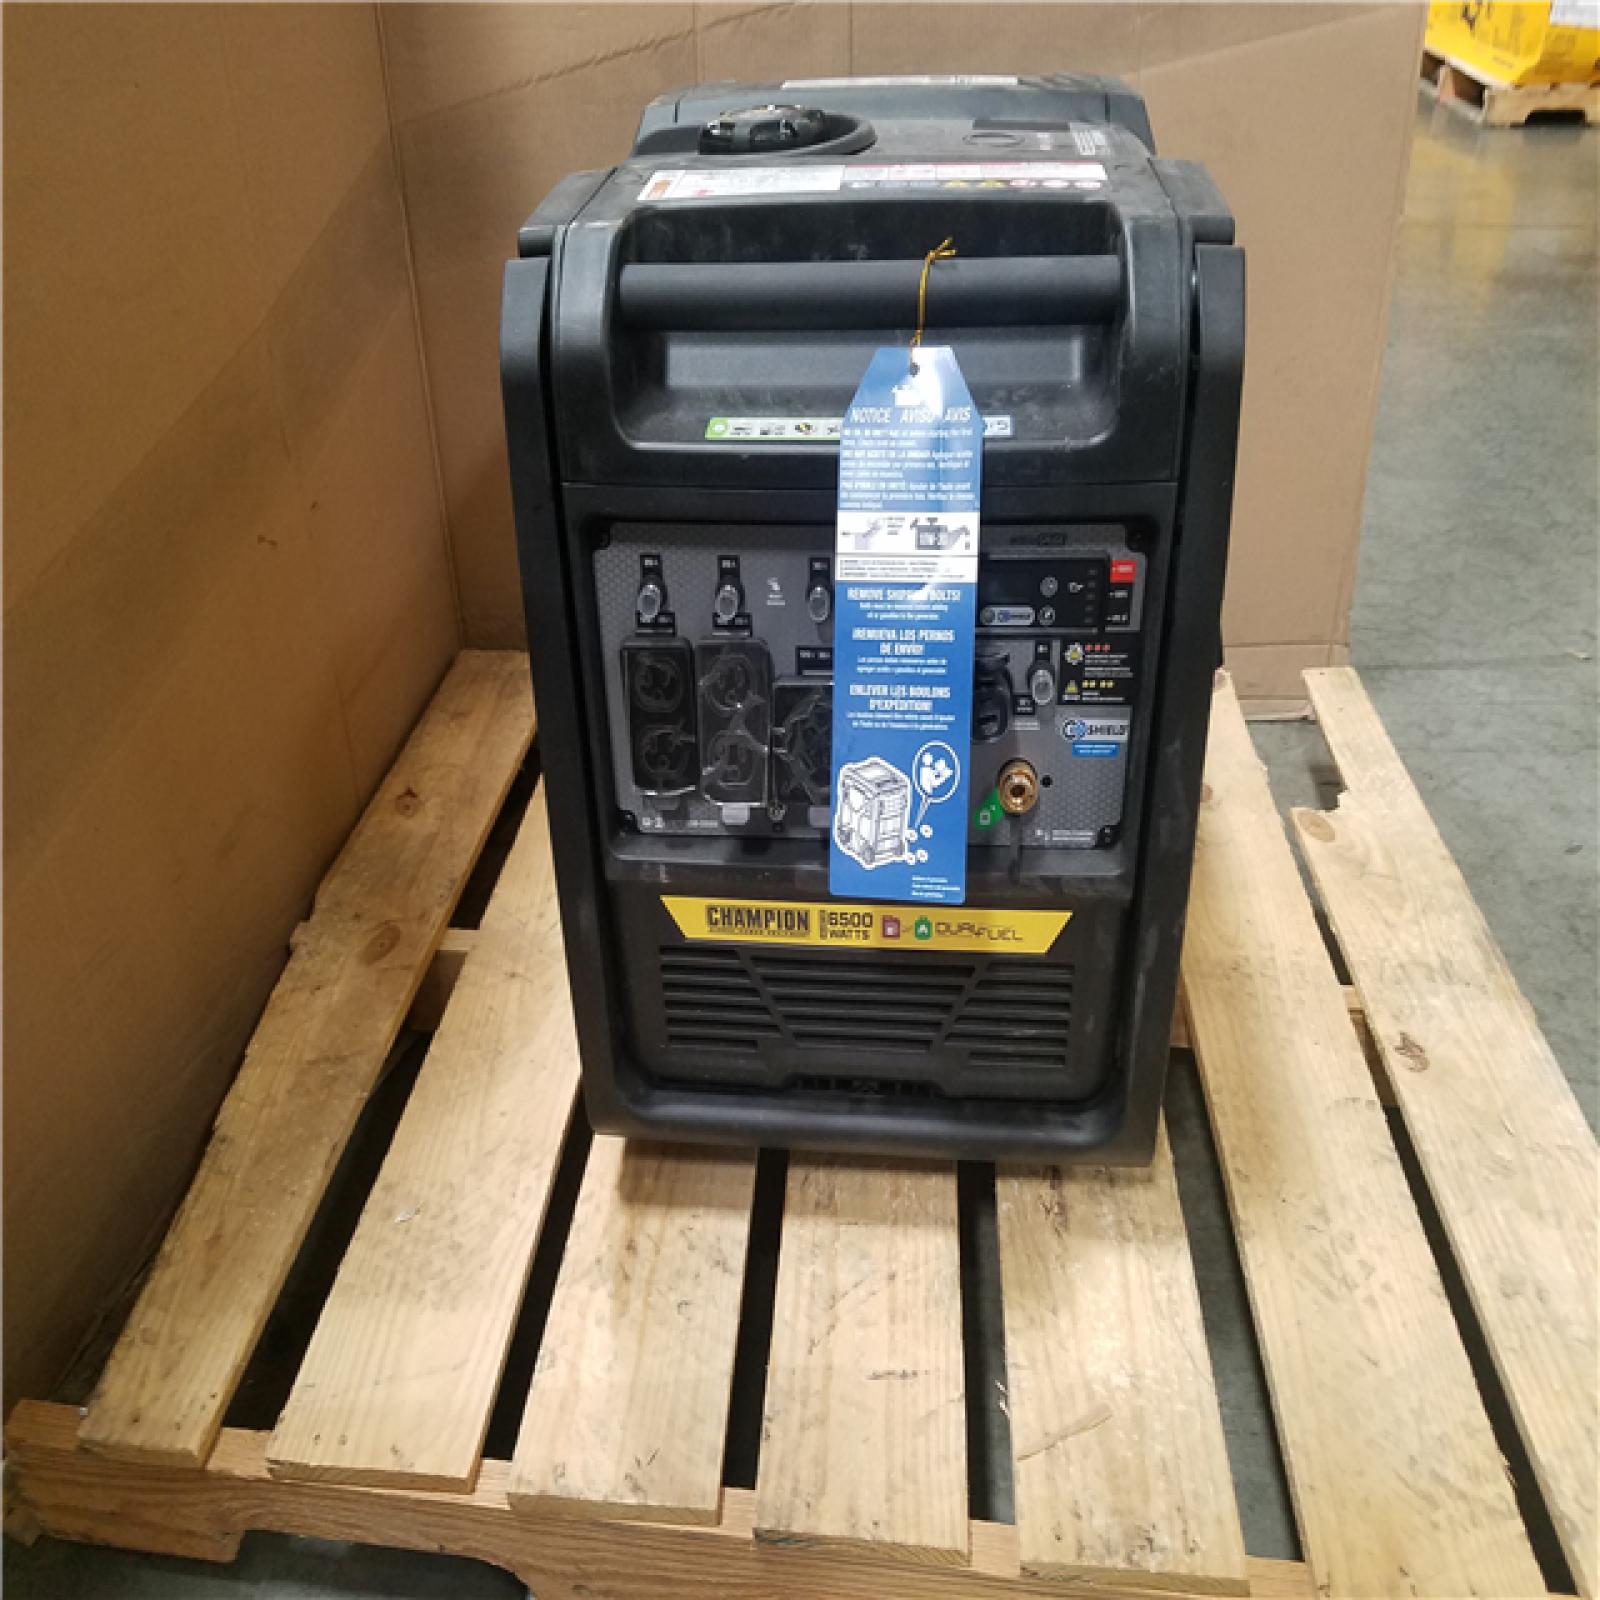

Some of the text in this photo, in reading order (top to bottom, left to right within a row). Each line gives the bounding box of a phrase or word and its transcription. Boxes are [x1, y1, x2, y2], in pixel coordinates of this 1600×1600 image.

[850, 407, 892, 423] NOTICE
[847, 588, 884, 601] REMOVE
[707, 906, 809, 931] CHAMPION
[828, 911, 873, 928] 6500
[829, 928, 870, 940] WATTS
